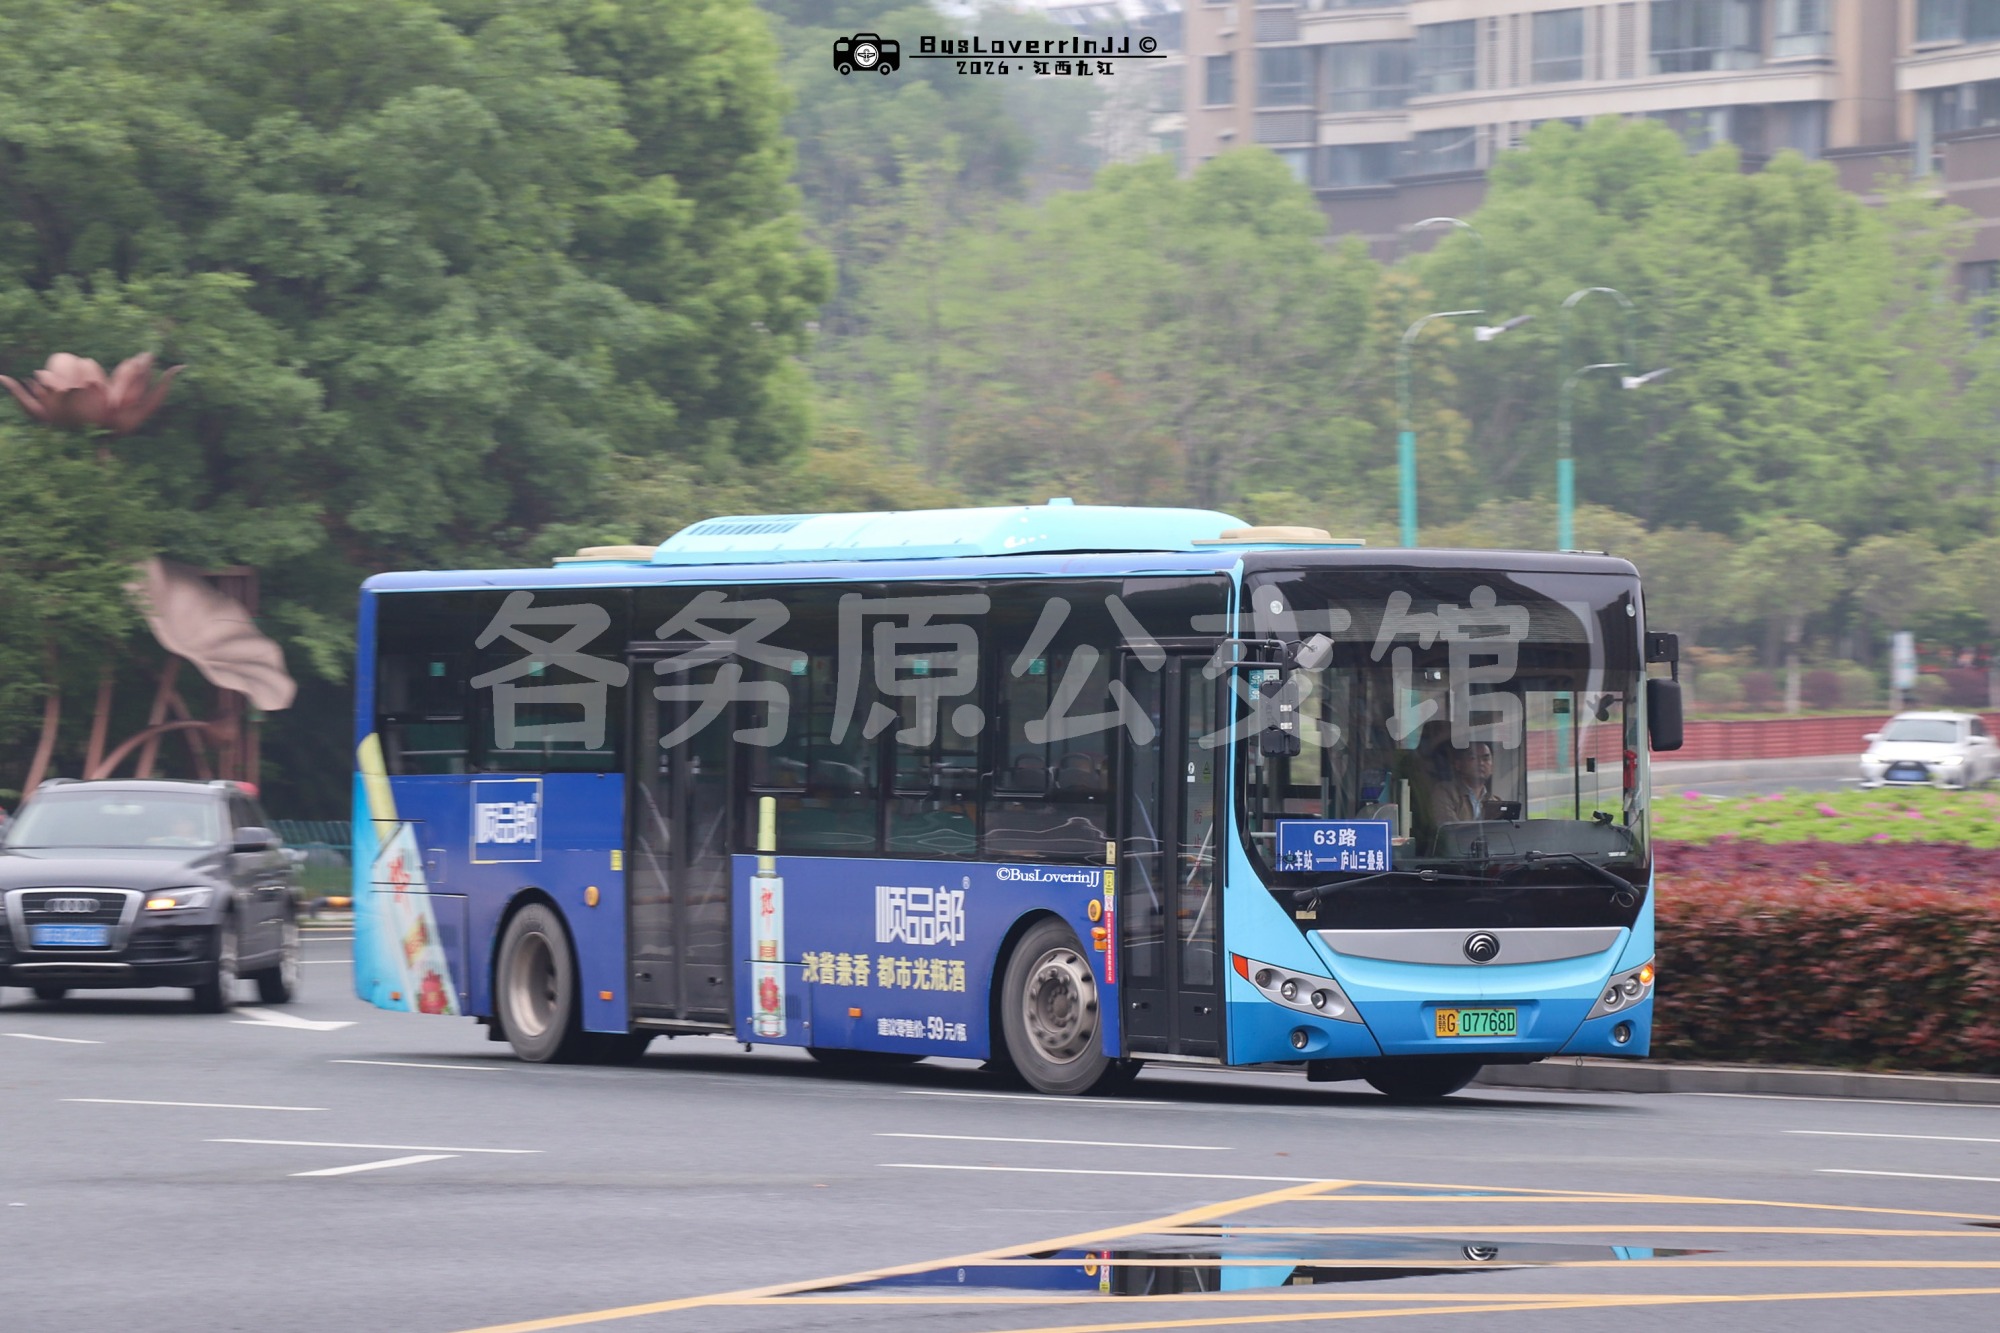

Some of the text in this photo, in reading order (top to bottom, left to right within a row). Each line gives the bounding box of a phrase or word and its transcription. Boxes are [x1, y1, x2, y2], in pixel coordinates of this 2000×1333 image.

[1313, 828, 1357, 847] 63路
[1340, 849, 1385, 870] 庐山三叠泉
[875, 885, 965, 946] 顺品郎
[802, 951, 966, 992] 浓酱兼香 都市光瓶酒
